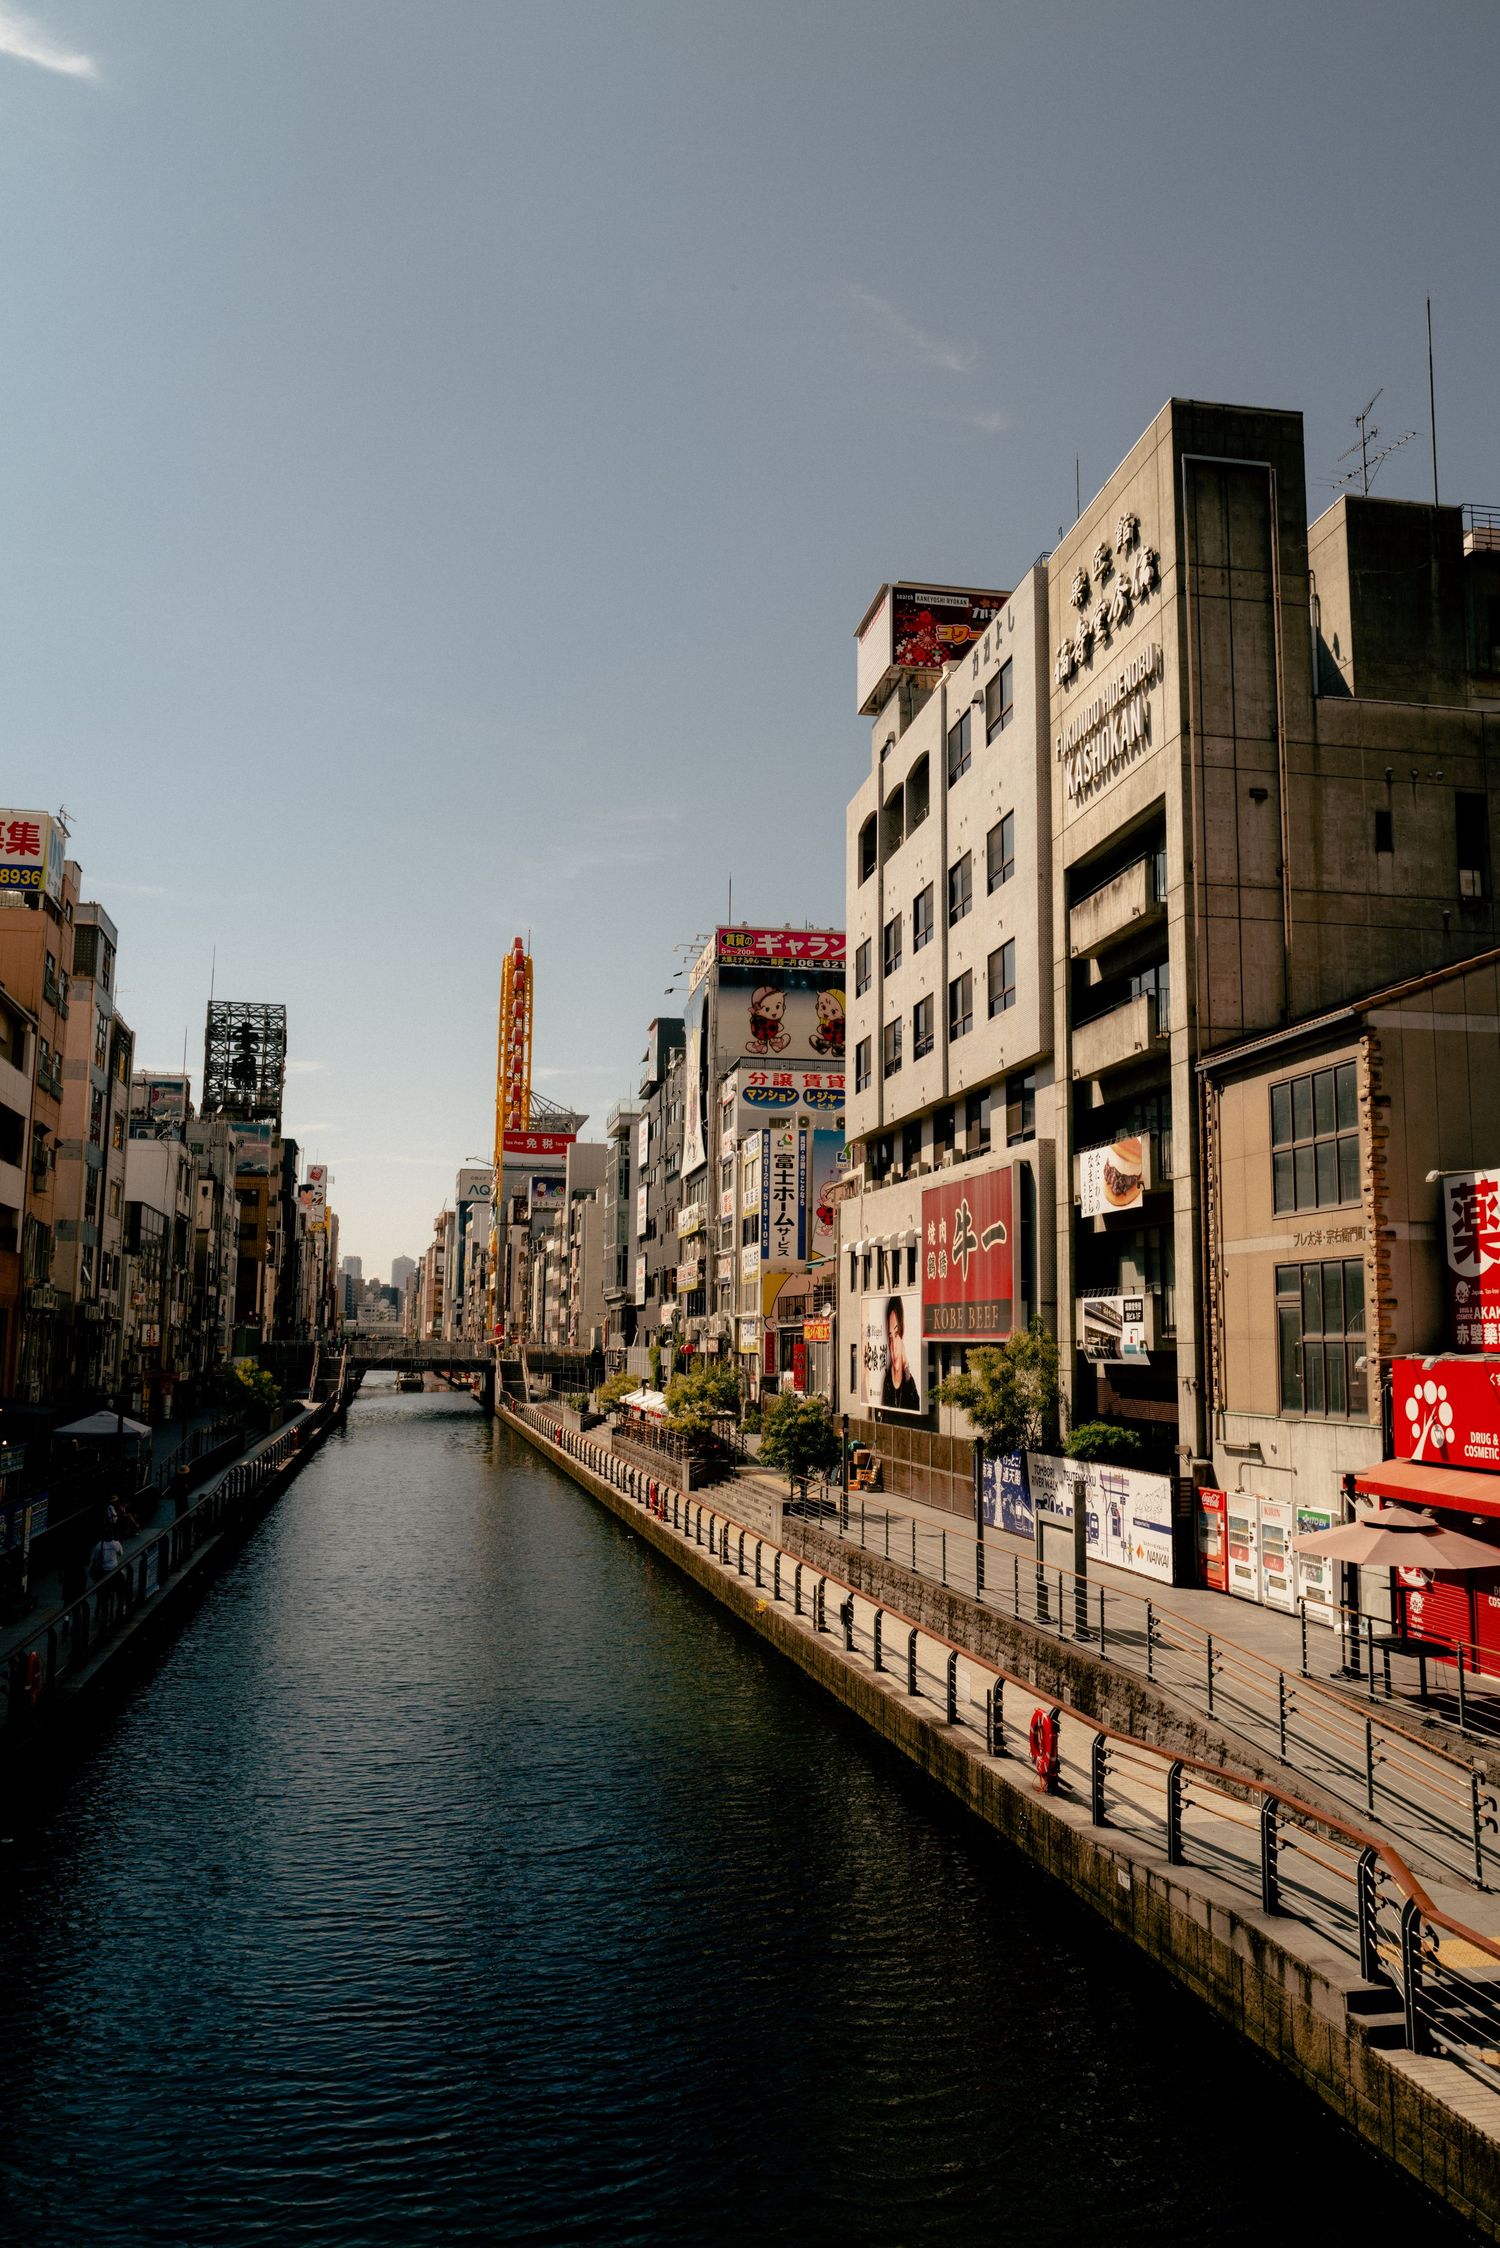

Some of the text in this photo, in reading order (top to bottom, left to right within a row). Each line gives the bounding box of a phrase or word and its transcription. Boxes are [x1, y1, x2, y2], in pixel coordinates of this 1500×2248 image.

[916, 594, 946, 604] KANEYOSHI
[946, 597, 968, 605] RYOKAN
[1104, 643, 1157, 716] HIDENOBU
[1066, 692, 1146, 799] KASHOKAN
[0, 821, 40, 856] 集
[748, 1071, 793, 1088] 分譲
[745, 1089, 797, 1103] マンション
[773, 1153, 795, 1257] 富士ホームサービス
[1450, 1178, 1500, 1265] 薬
[933, 1305, 999, 1330] KOBE BEEF
[1470, 1431, 1499, 1446] DRUG &
[1464, 1445, 1500, 1460] COSMETIC
[1264, 1507, 1280, 1518] KIRIN
[1146, 1550, 1169, 1568] NANKAI
